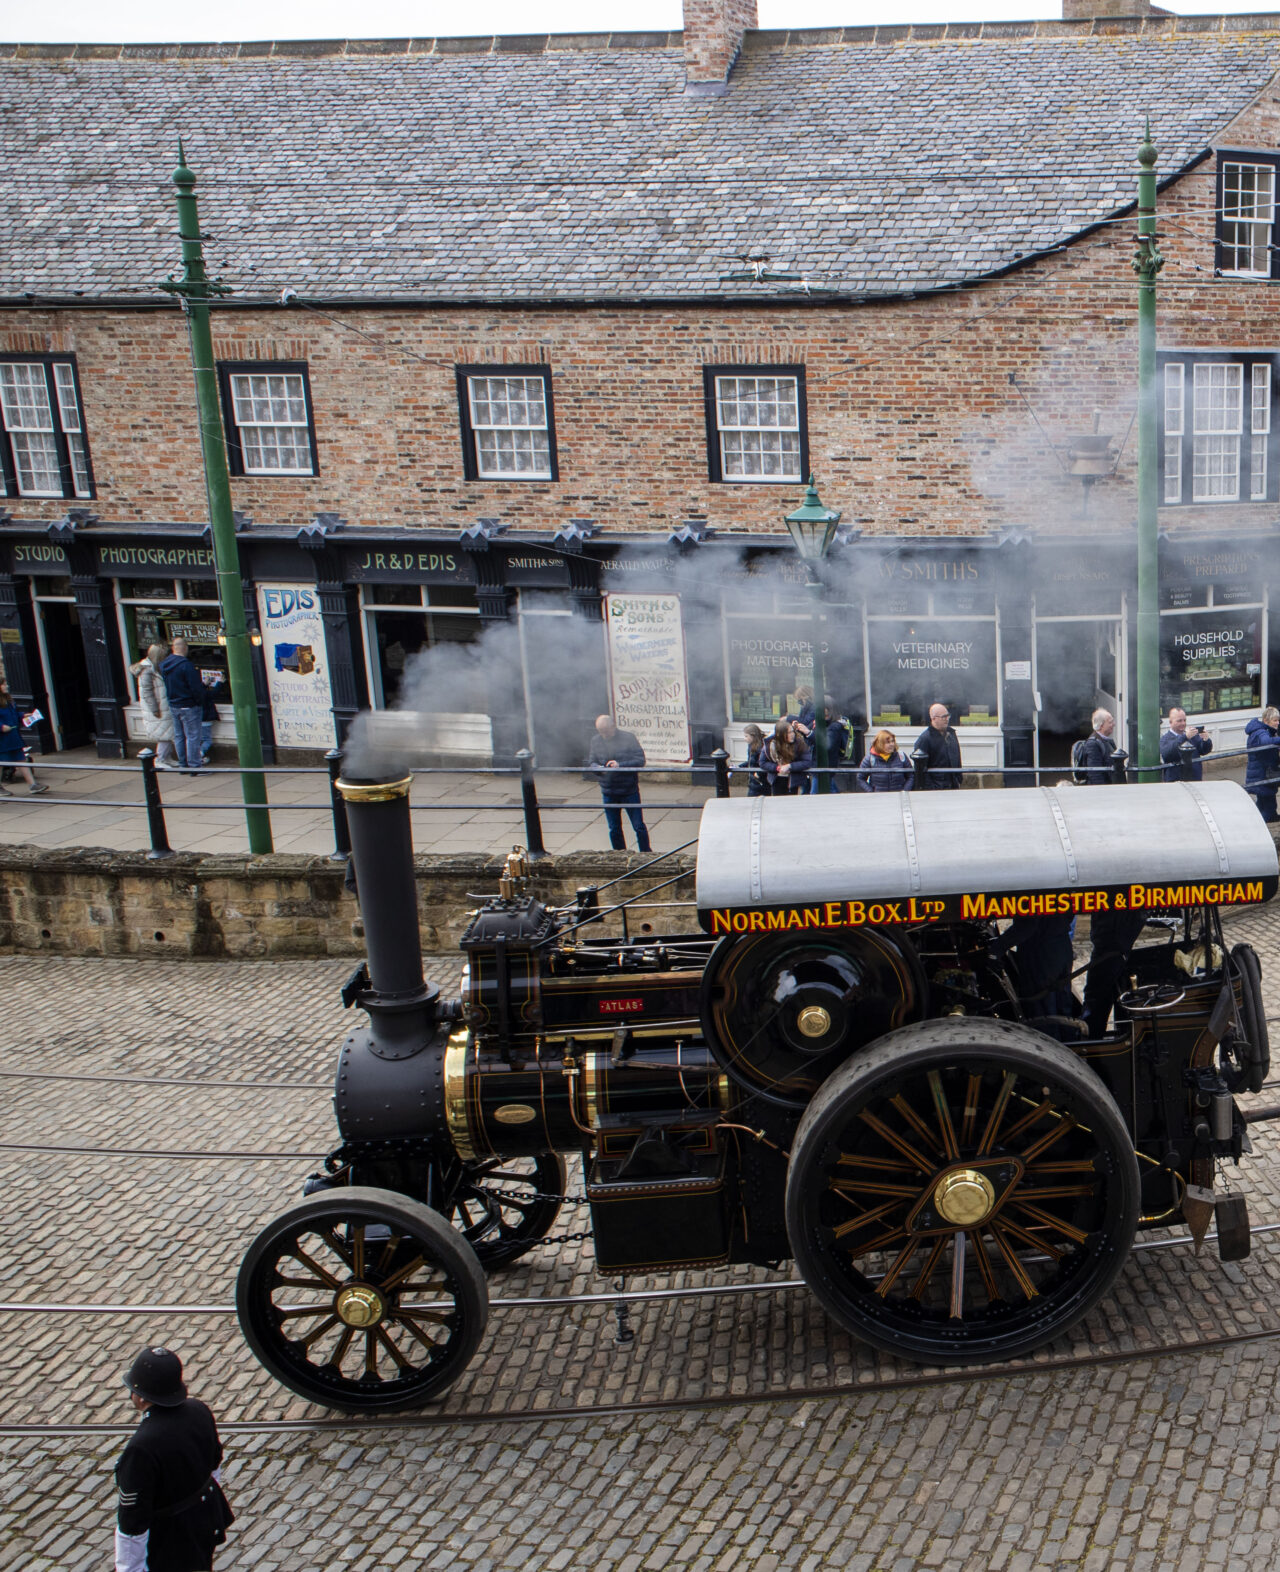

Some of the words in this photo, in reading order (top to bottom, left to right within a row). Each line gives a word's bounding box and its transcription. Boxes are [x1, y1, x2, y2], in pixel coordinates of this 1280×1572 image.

[15, 546, 65, 562] STUDIO
[507, 558, 541, 569] SMITH
[1195, 562, 1248, 577] PREPARED
[263, 589, 315, 618] EDIS
[611, 599, 659, 616] SMITH
[265, 612, 319, 630] PHOTOGRAPHER
[627, 611, 665, 624] SONS
[170, 629, 217, 638] FILMS
[1174, 630, 1244, 646] HOUSEHOLD
[731, 639, 829, 653] PHOTOGRAPHC
[893, 642, 973, 654] VETERINARY
[1182, 645, 1236, 661] SUPPLIES
[747, 655, 814, 668] MATERIALS
[898, 658, 970, 669] MEDICINES
[273, 680, 309, 692] STUDIO
[618, 677, 649, 700] BODY
[639, 682, 681, 702] MIND
[281, 691, 332, 704] PORTRAITS
[616, 701, 686, 716] SARSAPARILLA
[618, 715, 652, 728] BLOOD
[653, 716, 685, 729] TONIC
[961, 891, 1109, 919] MANCHESTER
[1114, 892, 1127, 908] &
[1128, 881, 1264, 910] BIRMINGHAM
[605, 1001, 638, 1011] ATLAS
